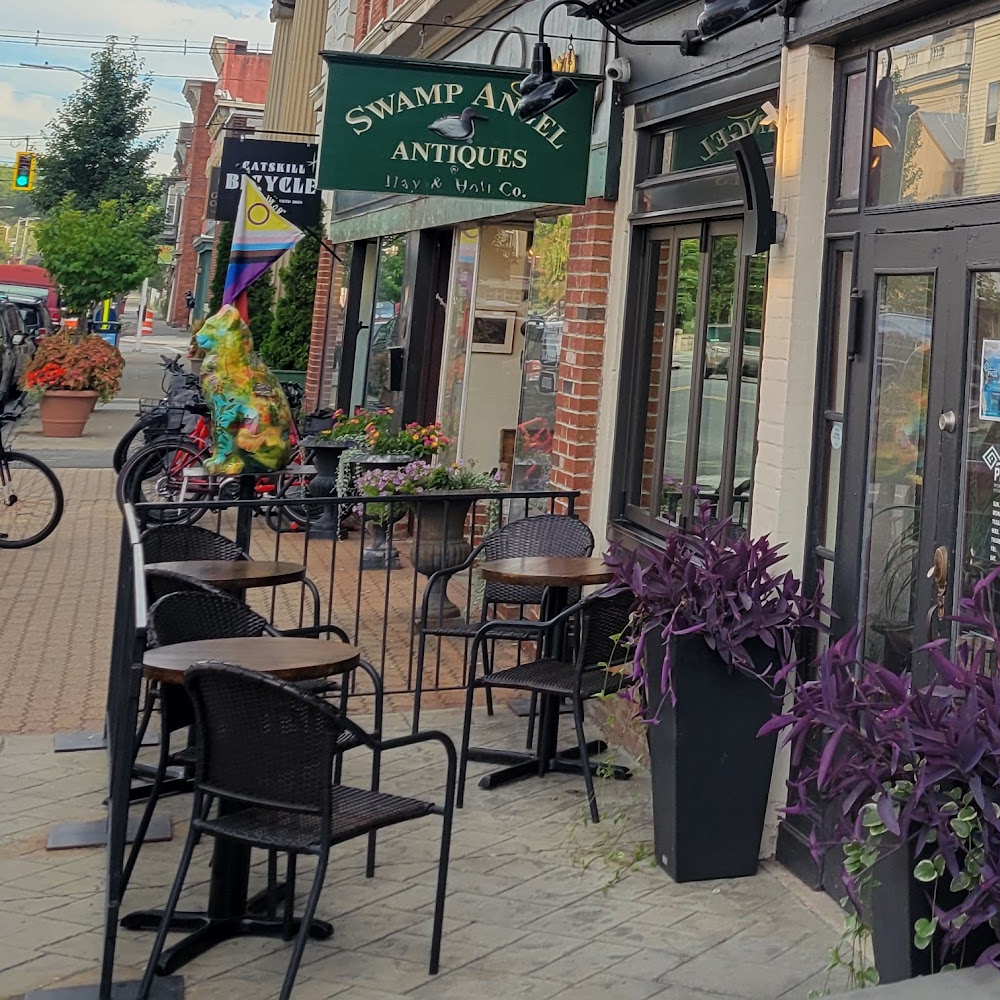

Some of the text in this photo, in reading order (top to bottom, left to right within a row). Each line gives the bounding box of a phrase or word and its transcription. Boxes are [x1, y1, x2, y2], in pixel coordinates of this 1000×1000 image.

[345, 82, 567, 150] SWAMP ANEL
[390, 140, 528, 169] ANTIQUES
[242, 161, 306, 174] CATSKILL
[498, 181, 527, 199] Co.
